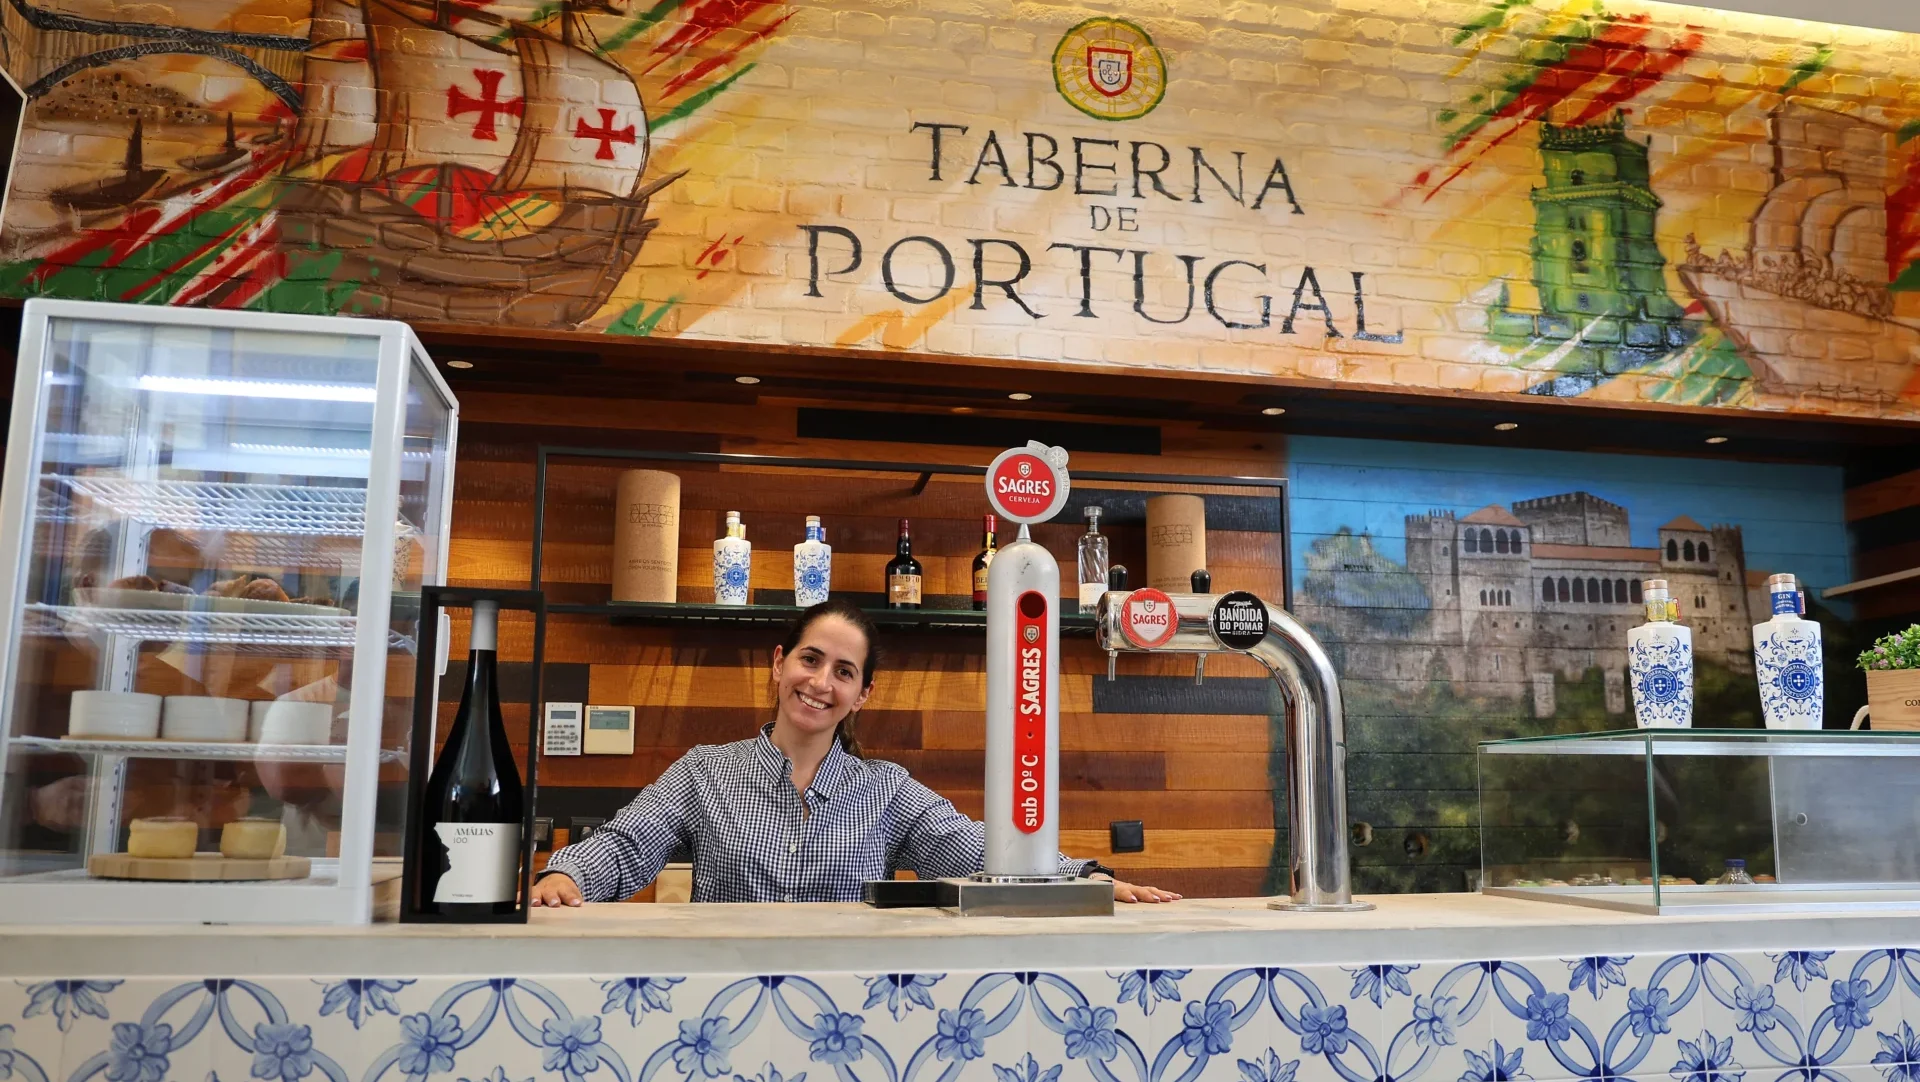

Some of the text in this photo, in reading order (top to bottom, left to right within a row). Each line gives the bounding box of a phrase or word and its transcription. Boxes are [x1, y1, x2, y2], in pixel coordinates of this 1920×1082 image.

[909, 121, 1305, 215] TABERNA
[1089, 204, 1140, 233] DE
[796, 223, 1404, 344] PORTUGAL
[998, 476, 1050, 496] SAGRES
[1008, 495, 1041, 504] CERVEJA
[905, 575, 920, 583] 970
[1132, 613, 1167, 626] SAGRES
[1219, 607, 1263, 623] BANDIDA
[1219, 621, 1264, 631] DO POMAR
[1783, 664, 1812, 677] COMPANHIA
[1020, 647, 1042, 716] SAGRES
[1021, 754, 1039, 767] C
[1020, 796, 1038, 827] sub
[454, 826, 494, 836] AMÁLIAS
